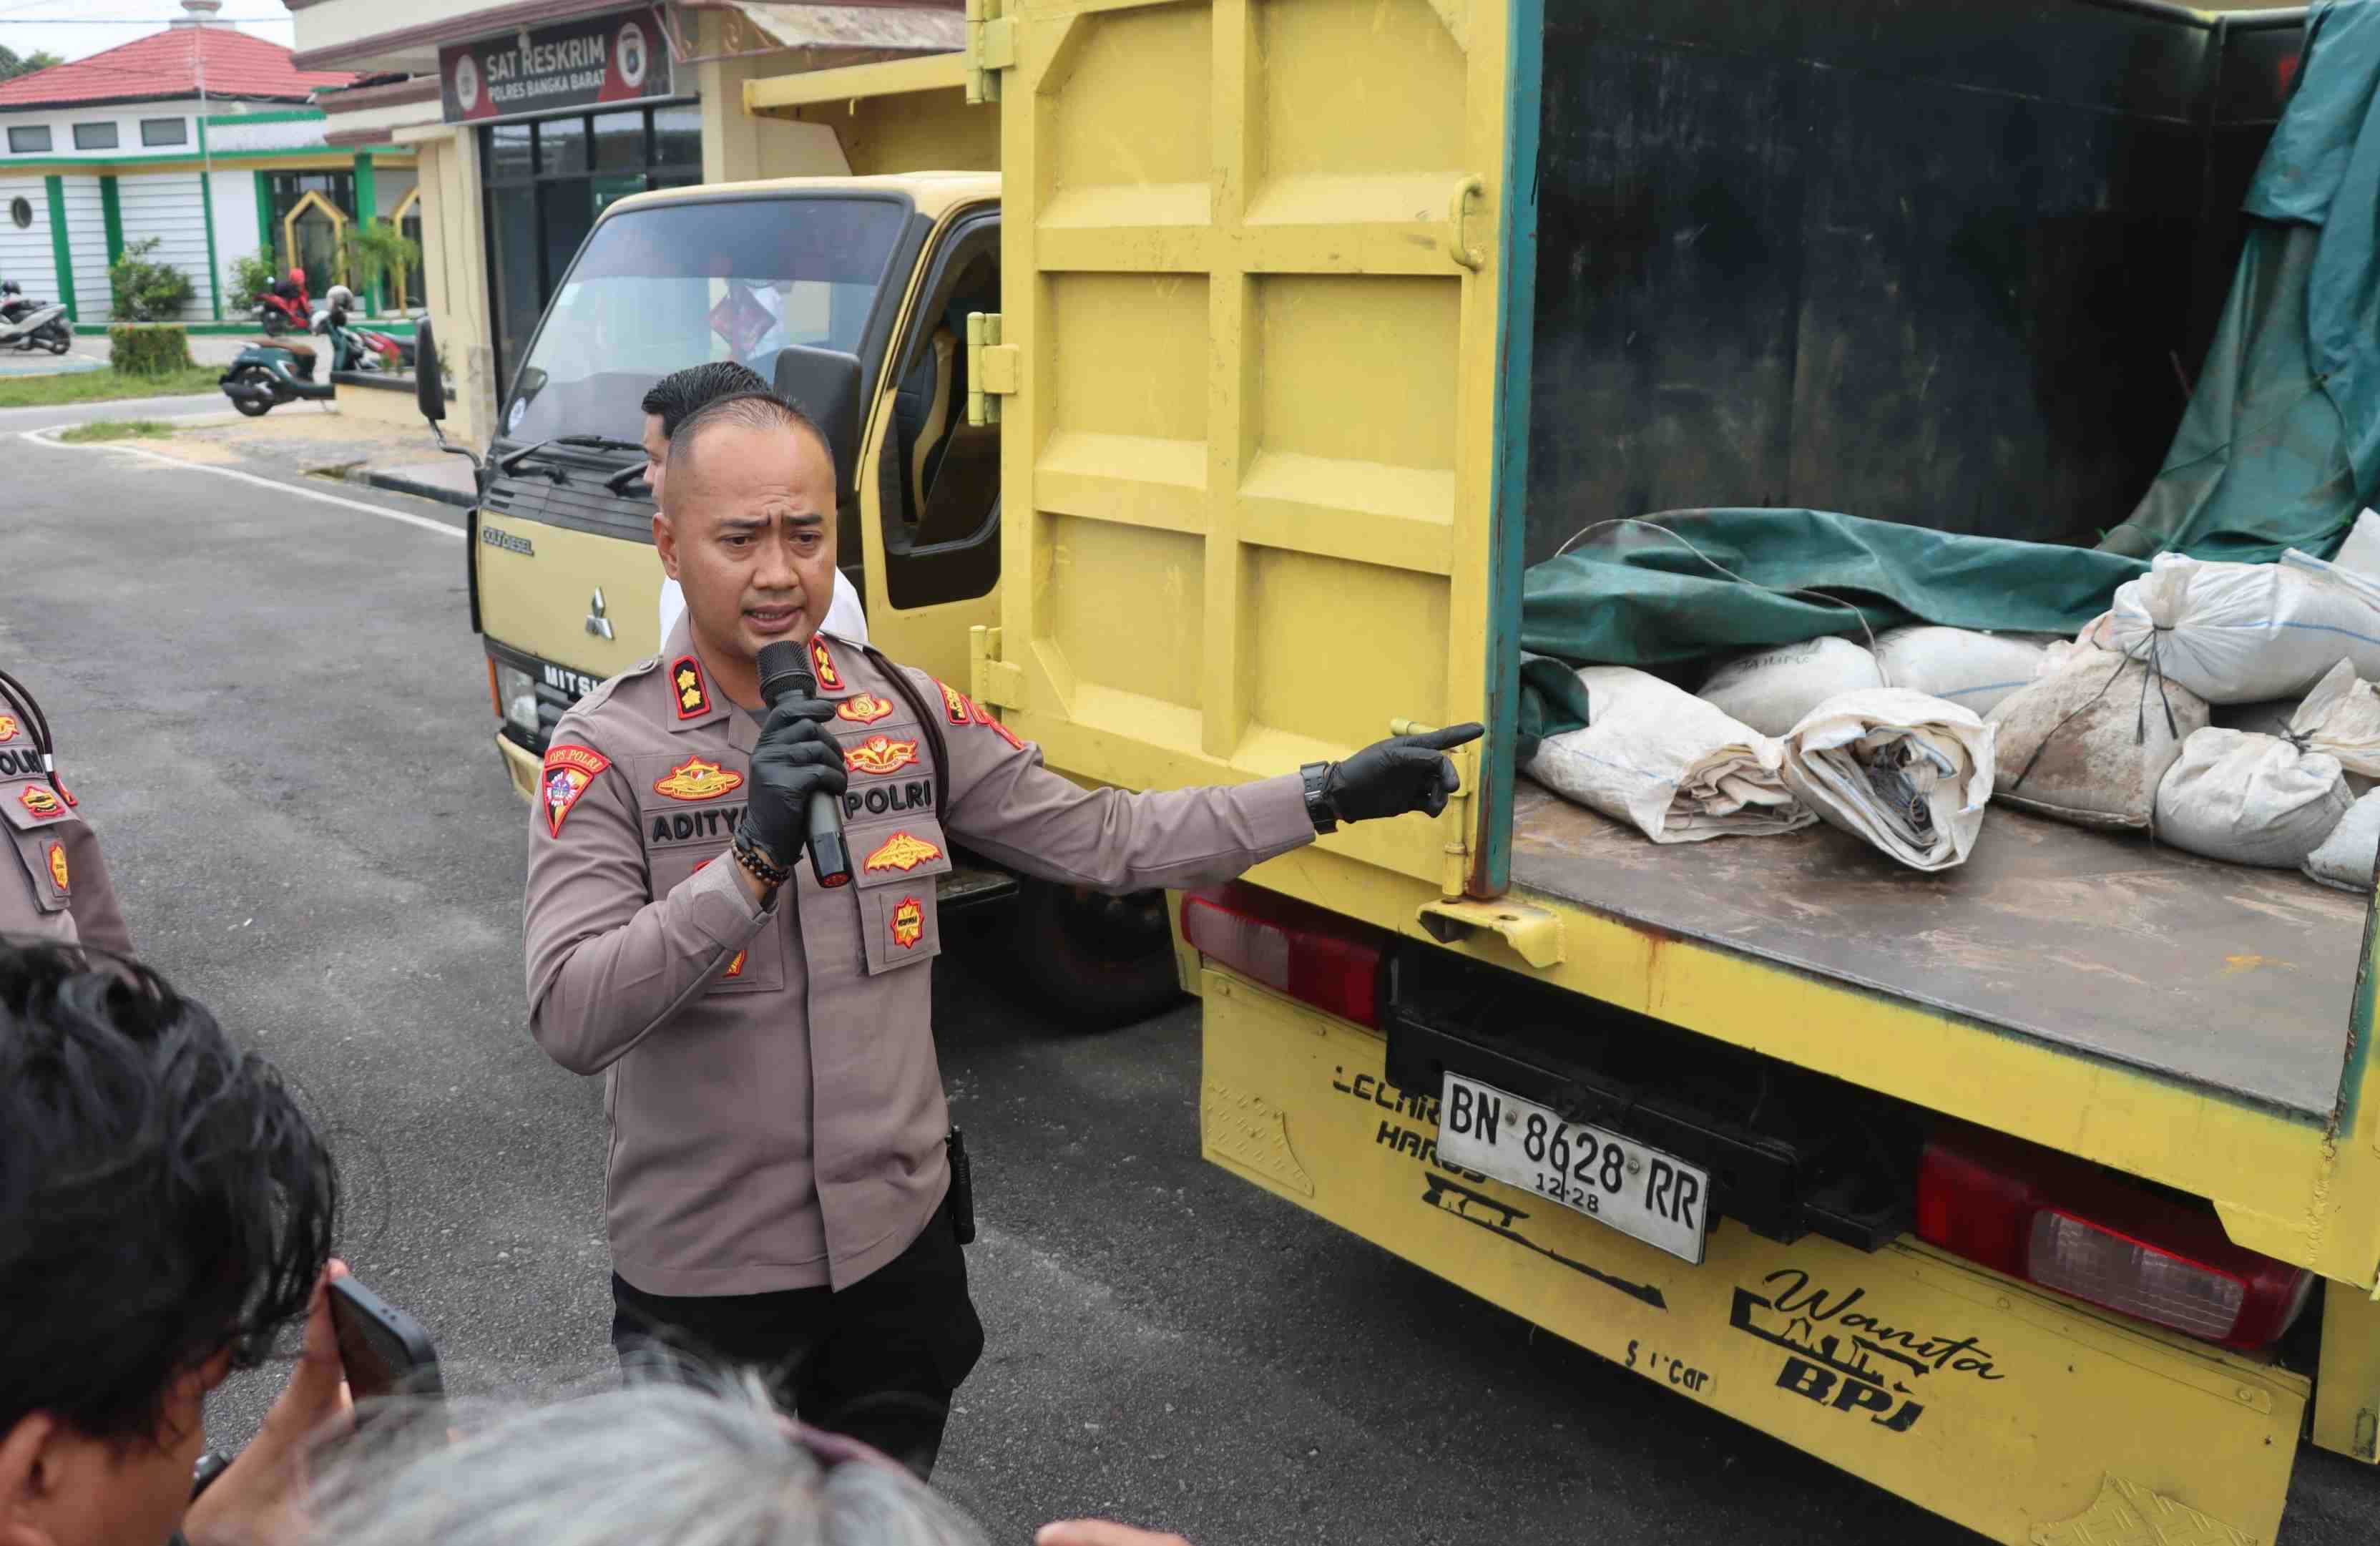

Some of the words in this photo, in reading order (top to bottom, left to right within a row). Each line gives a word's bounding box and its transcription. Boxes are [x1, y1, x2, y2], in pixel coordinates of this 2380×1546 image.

[486, 50, 517, 82] SAT
[521, 34, 606, 76] RESKRIM
[488, 82, 526, 103] POLRES
[527, 75, 569, 97] BANGKA
[570, 69, 606, 92] BARAT
[549, 749, 567, 763] OPS
[568, 749, 602, 769] POLRI
[842, 779, 931, 820] POLRI
[1449, 1083, 1502, 1145] BN
[1524, 1112, 1625, 1194] 8628
[1645, 1157, 1699, 1230] RR
[1763, 1269, 2005, 1381] Wanita
